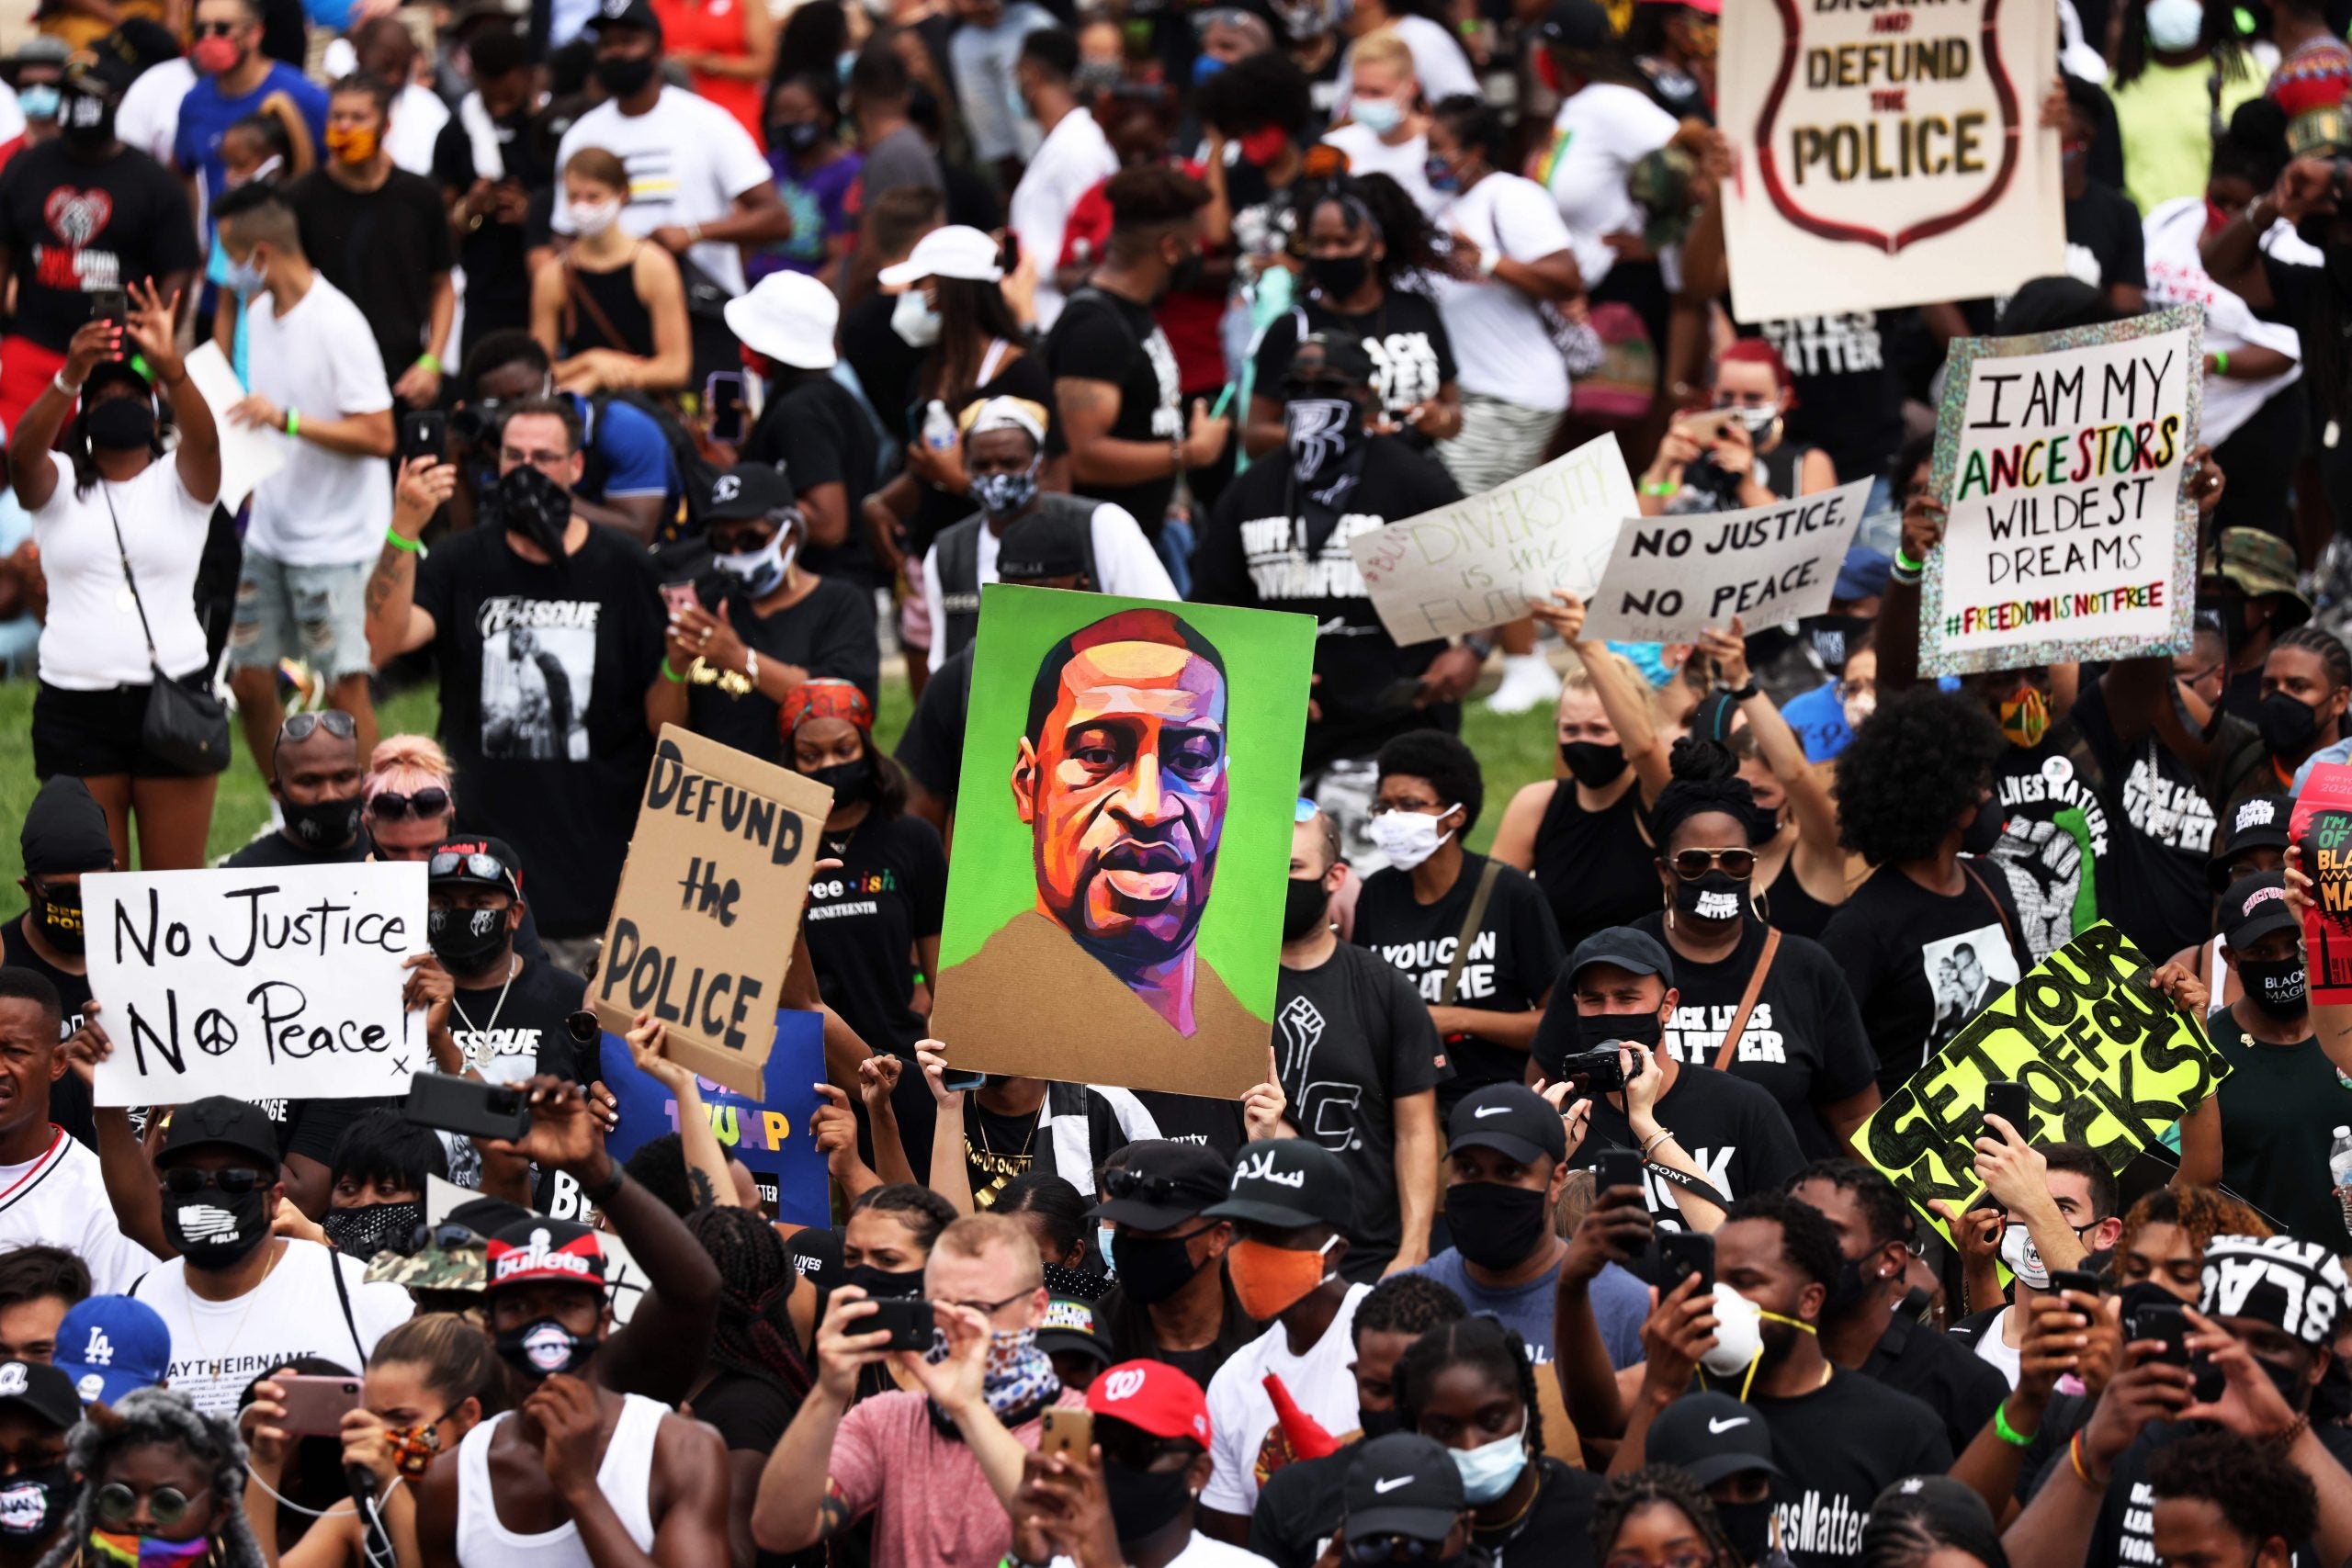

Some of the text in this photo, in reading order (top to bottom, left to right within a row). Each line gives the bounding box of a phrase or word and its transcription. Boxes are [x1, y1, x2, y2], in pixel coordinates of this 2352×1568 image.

[1807, 37, 1971, 89] DEFUND
[1792, 111, 1987, 186] POLICE
[1969, 349, 2173, 429] I AM MY
[1957, 415, 2180, 502] ANCESTORS
[1410, 445, 1608, 567] DIVERSITY
[1630, 496, 1847, 558] NO JUSTICE,
[1987, 476, 2154, 542] WILDEST
[1620, 557, 1820, 617] NO PEACE.
[1988, 534, 2143, 585] DREAMS
[647, 739, 804, 867] DEFUND
[1996, 773, 2046, 807] LIVES
[2318, 829, 2349, 850] OF
[677, 856, 741, 929] the
[114, 885, 408, 967] No Justice
[599, 917, 763, 1052] POLICE
[1868, 924, 2155, 1171] GET YOUR
[1230, 1148, 1305, 1192] سلام
[1647, 1162, 1693, 1185] SONY
[209, 1230, 240, 1245] #BLM
[495, 1228, 590, 1280] bullets
[793, 1254, 822, 1271] LIVES
[84, 1325, 114, 1366] LA
[1104, 1368, 1146, 1402] W
